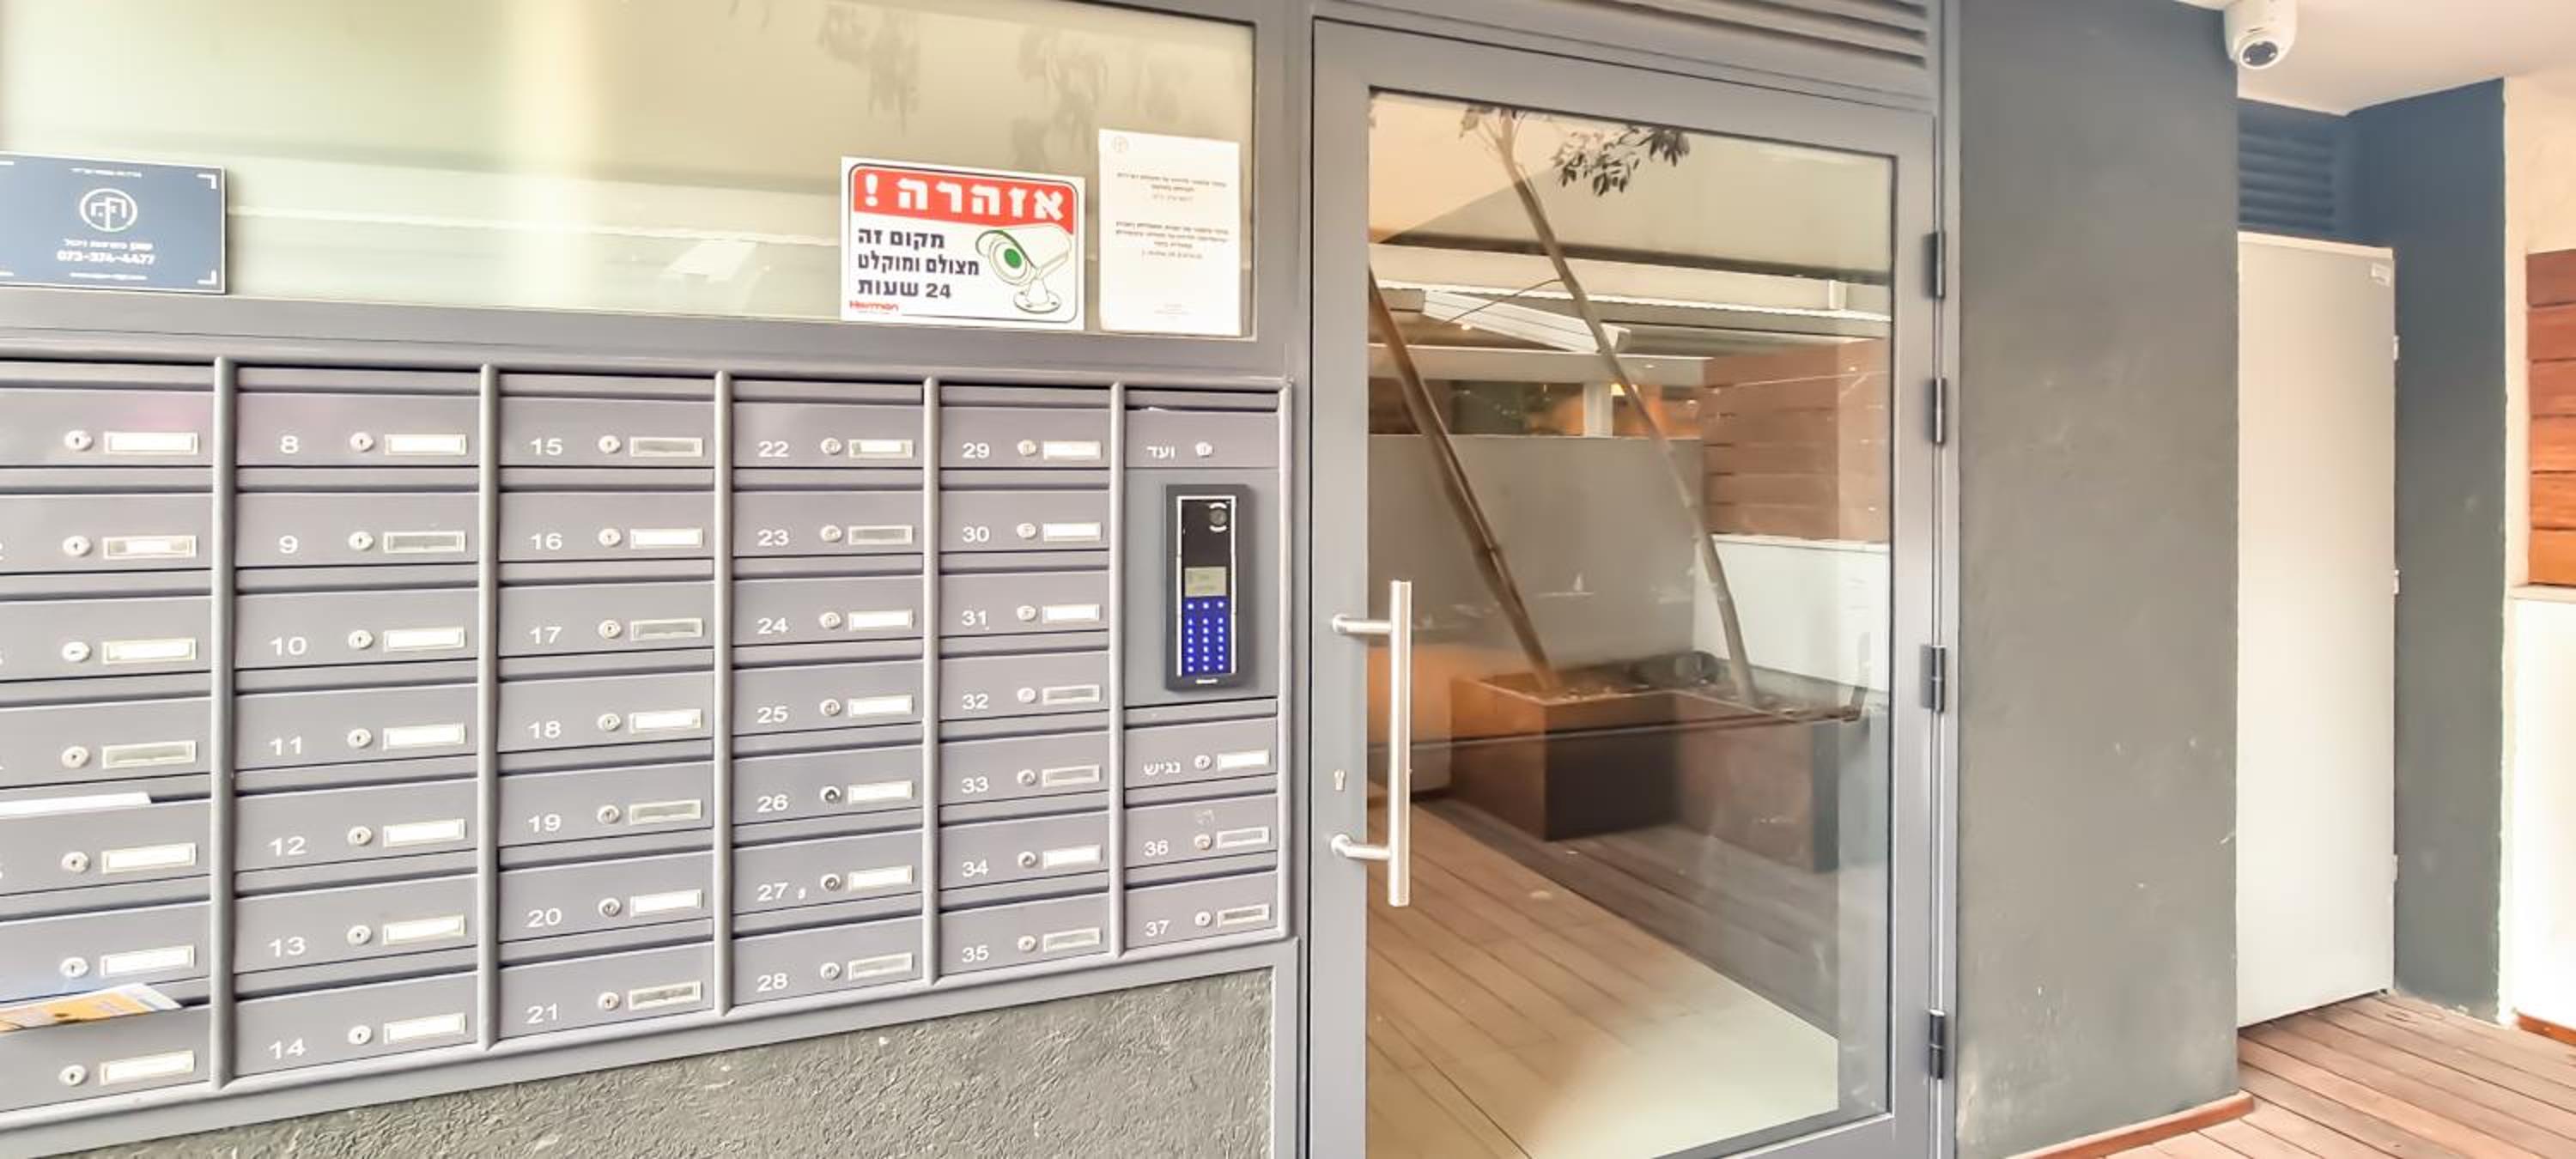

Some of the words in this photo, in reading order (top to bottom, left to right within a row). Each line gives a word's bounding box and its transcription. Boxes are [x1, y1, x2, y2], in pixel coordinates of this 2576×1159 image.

[897, 178, 1064, 221] אזהרה
[858, 228, 883, 244] זה
[890, 231, 945, 251] מקום
[857, 252, 920, 274] ומוקלט
[926, 255, 980, 276] מצולם
[858, 279, 919, 297] שעות
[926, 283, 951, 299] 24
[280, 435, 300, 454] 8
[531, 437, 563, 456] 15
[758, 440, 789, 458] 22
[962, 442, 990, 459] 29
[1146, 446, 1176, 459] ועד
[531, 532, 562, 550] 16
[757, 529, 789, 547] 23
[962, 525, 990, 543] 30
[278, 535, 299, 554] 9
[757, 617, 789, 634] 24
[961, 610, 987, 627] 31
[530, 626, 562, 645] 17
[270, 636, 307, 656] 10
[962, 693, 988, 710] 32
[756, 705, 788, 724] 25
[528, 720, 562, 739] 18
[270, 736, 302, 756] 11
[1143, 762, 1181, 776] נגיש
[961, 776, 989, 794] 33
[756, 793, 788, 813] 26
[528, 813, 562, 833] 19
[270, 835, 307, 857] 12
[1145, 840, 1169, 857] 36
[962, 859, 989, 877] 34
[757, 882, 789, 902] 27
[526, 907, 562, 928] 20
[1145, 919, 1170, 937] 37
[269, 936, 306, 957] 13
[961, 944, 990, 962] 35
[756, 973, 788, 992] 28
[526, 1003, 557, 1024] 21
[269, 1038, 307, 1060] 14
